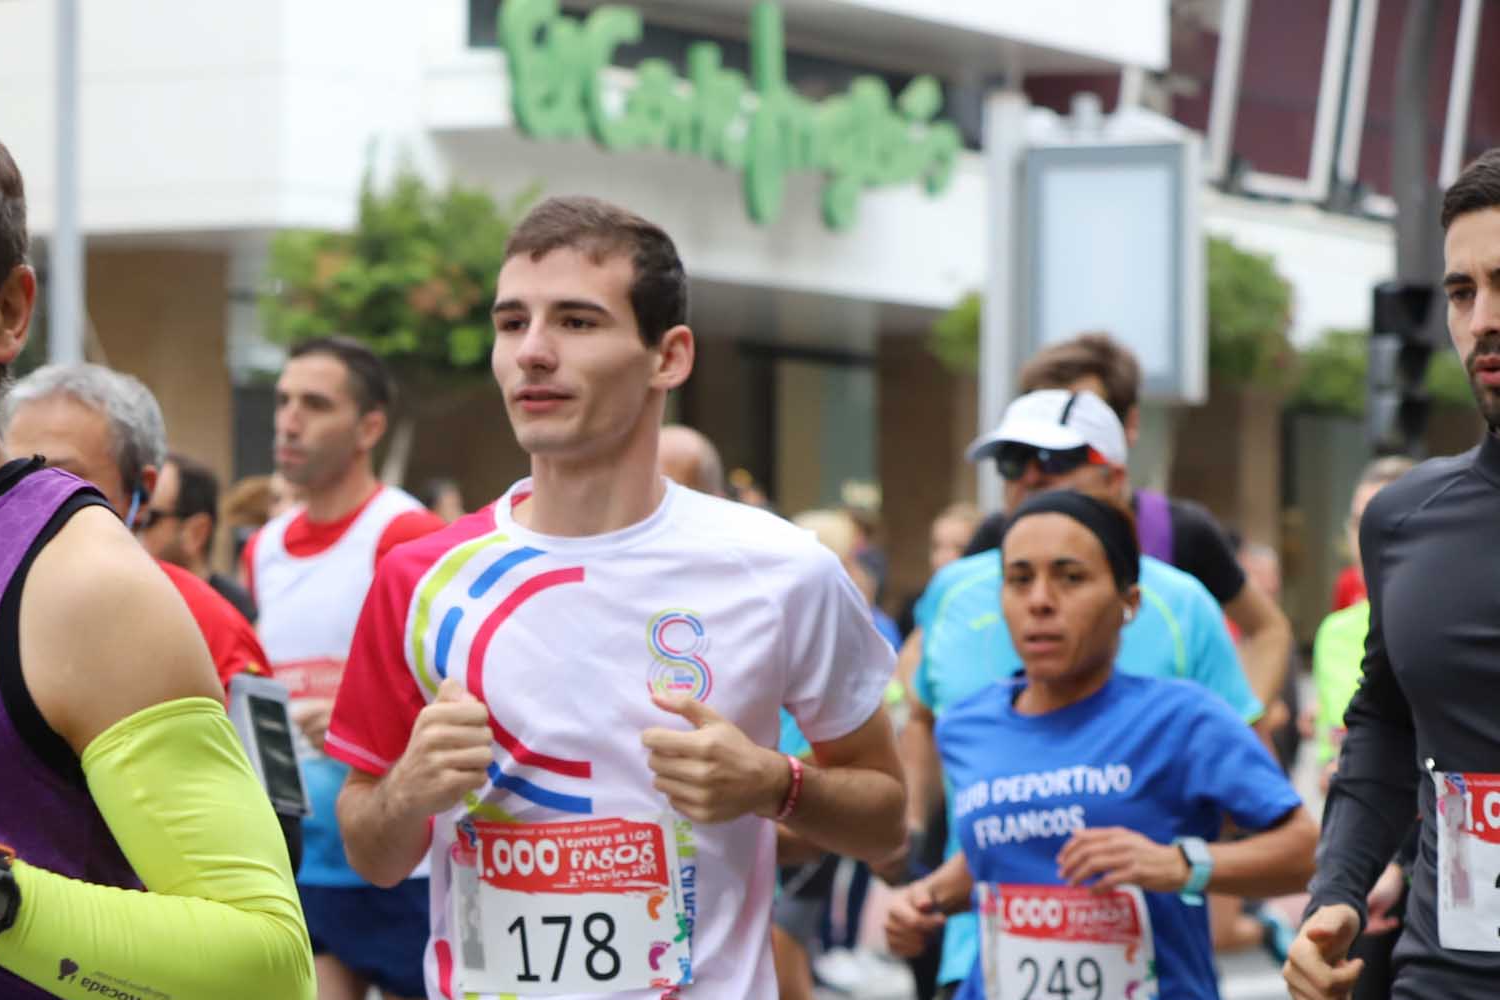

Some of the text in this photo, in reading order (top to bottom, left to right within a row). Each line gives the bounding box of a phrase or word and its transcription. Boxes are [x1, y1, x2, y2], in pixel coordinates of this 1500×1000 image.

[991, 763, 1132, 804] DEPORTIVO
[973, 804, 1085, 849] FRANCOS
[476, 838, 560, 878] 1.000
[570, 843, 656, 870] PASOS
[507, 911, 621, 983] 178
